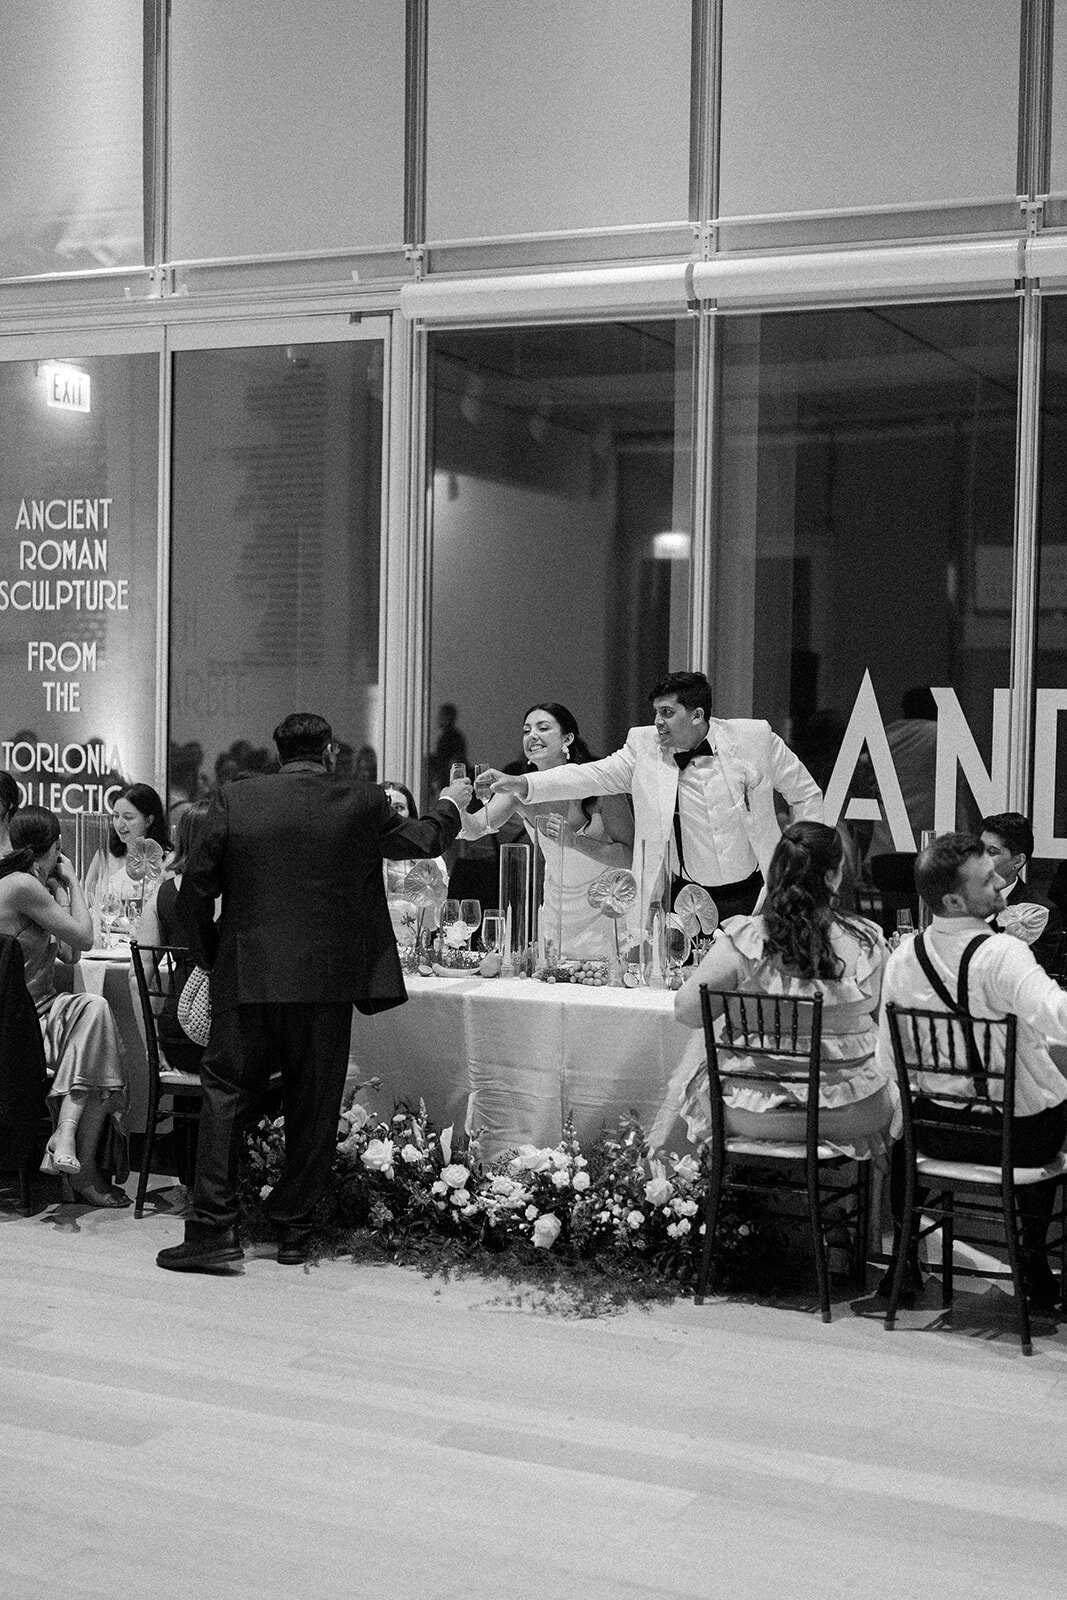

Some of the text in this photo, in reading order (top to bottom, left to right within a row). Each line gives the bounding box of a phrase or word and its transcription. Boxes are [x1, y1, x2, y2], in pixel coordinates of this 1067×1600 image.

[53, 374, 83, 406] EXIT
[15, 498, 113, 533] ANCIENT
[19, 536, 107, 573] ROMAN
[0, 580, 129, 612] SCULPTURE
[28, 641, 97, 672] FROM
[42, 682, 81, 712] THE
